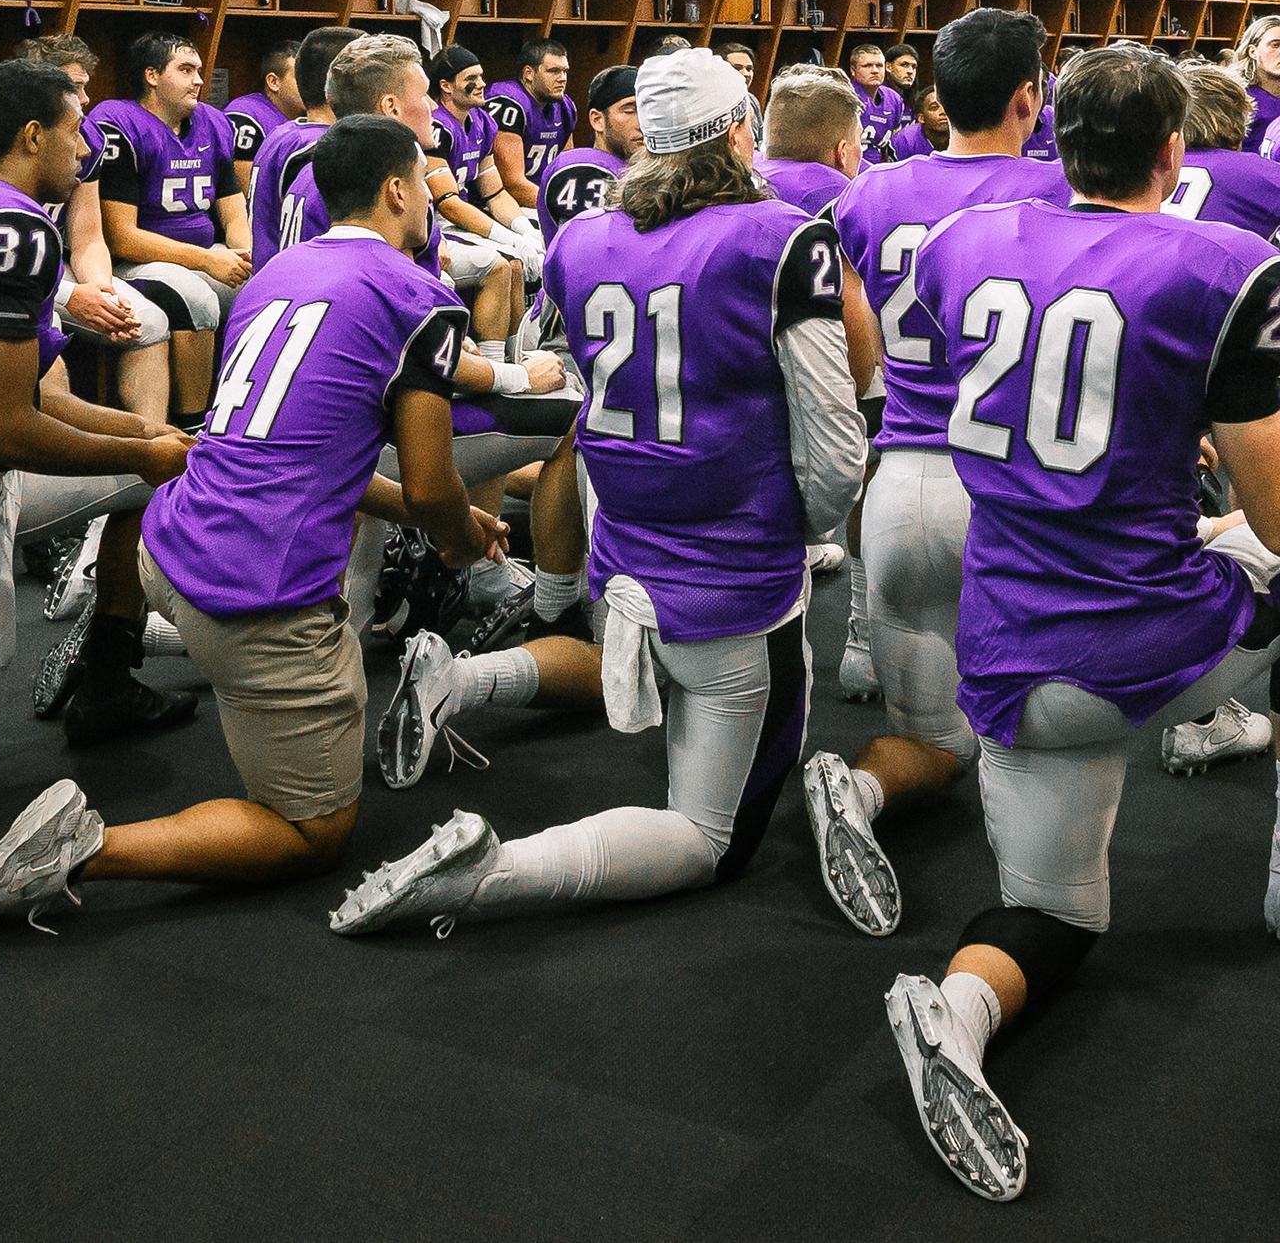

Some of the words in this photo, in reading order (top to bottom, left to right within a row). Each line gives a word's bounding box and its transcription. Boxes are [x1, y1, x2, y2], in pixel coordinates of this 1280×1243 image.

[489, 103, 519, 127] 70
[103, 133, 120, 160] 5
[237, 124, 257, 150] 6
[431, 127, 442, 149] 4
[161, 174, 212, 213] 55
[555, 177, 608, 211] 43
[879, 223, 932, 366] 2
[432, 310, 457, 376] 4
[208, 298, 331, 441] 41
[584, 281, 683, 446] 21
[946, 276, 1126, 477] 20
